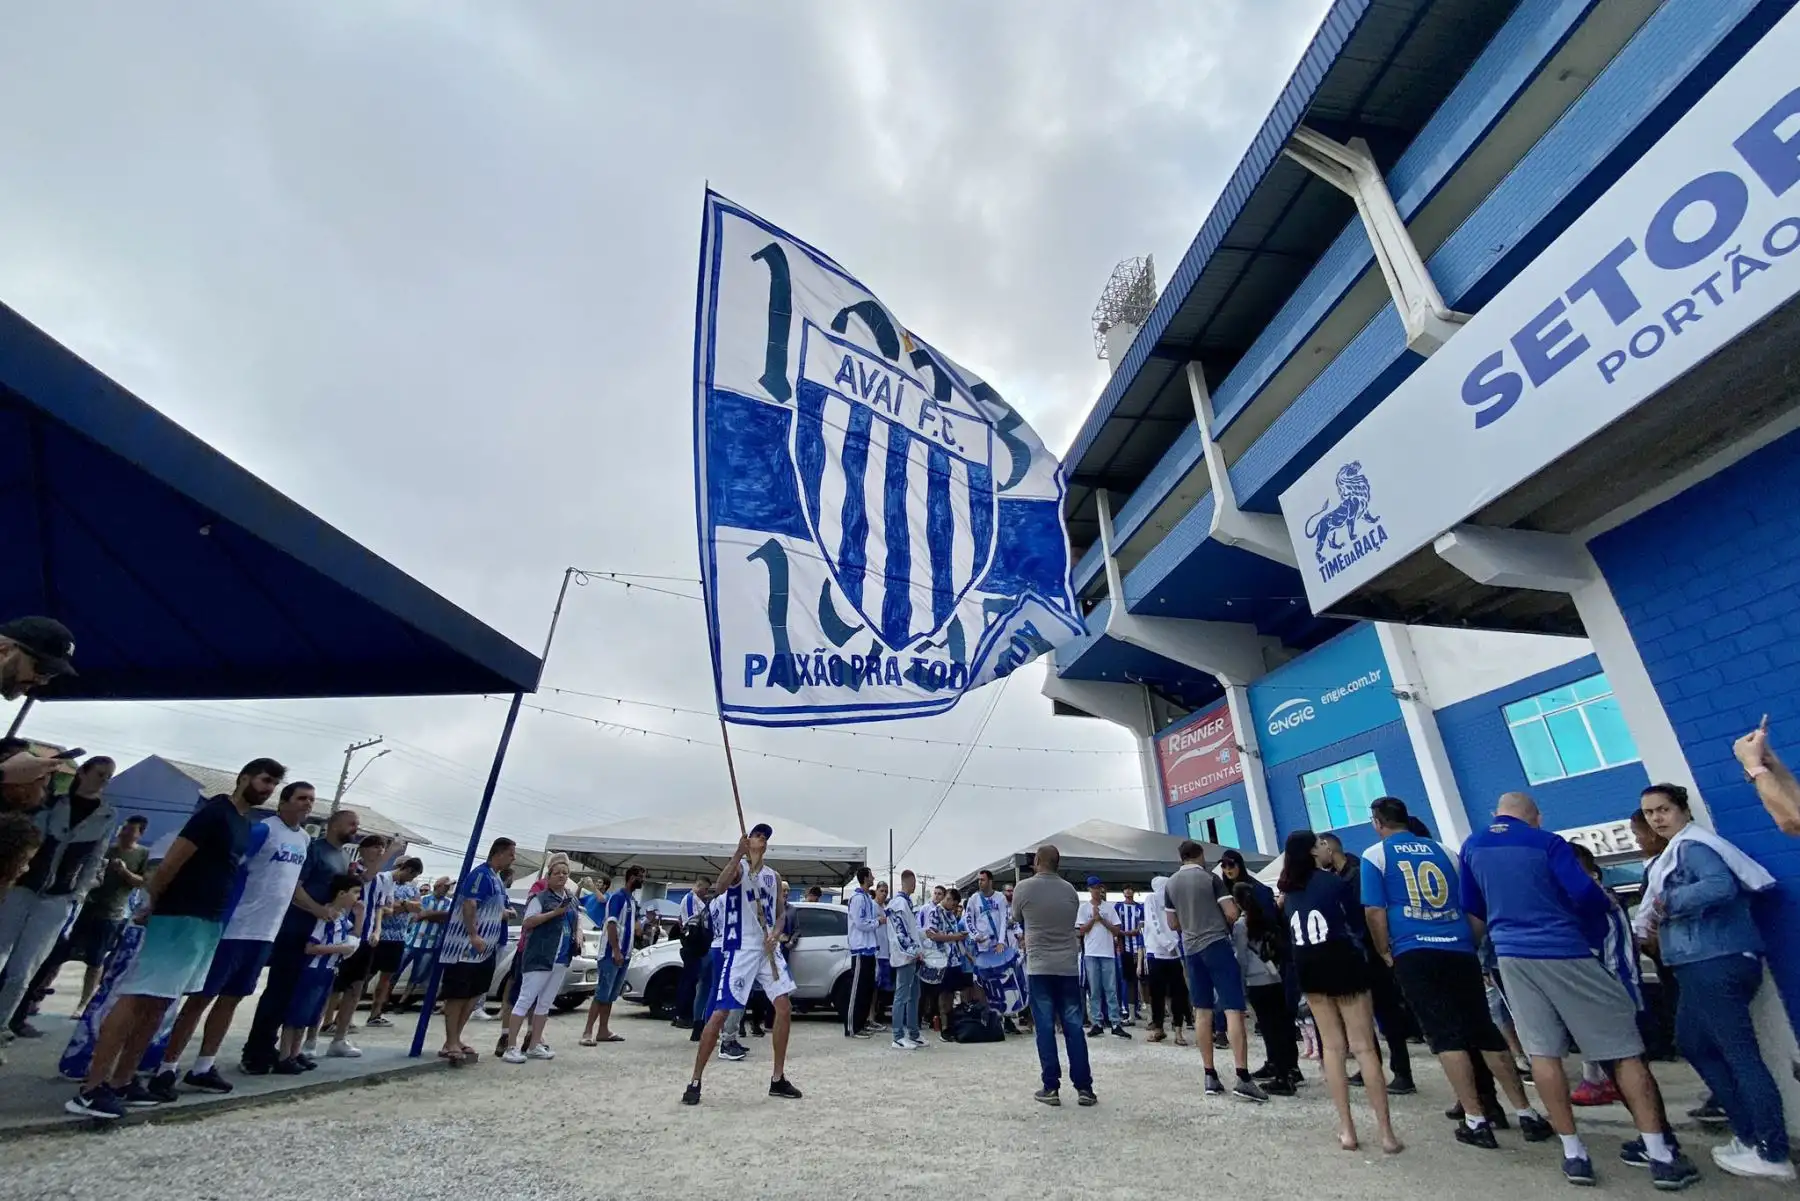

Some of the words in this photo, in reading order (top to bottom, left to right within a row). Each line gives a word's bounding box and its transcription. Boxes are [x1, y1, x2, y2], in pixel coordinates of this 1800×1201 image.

[1597, 216, 1800, 384] PORTÃO
[851, 653, 902, 686] PRA
[910, 657, 969, 690] TOD
[1320, 668, 1381, 704] engie.com.br
[1168, 718, 1225, 755] RENNER
[1179, 762, 1242, 794] TECNOTINTAS
[1397, 860, 1448, 908] 10
[1290, 909, 1329, 946] 10
